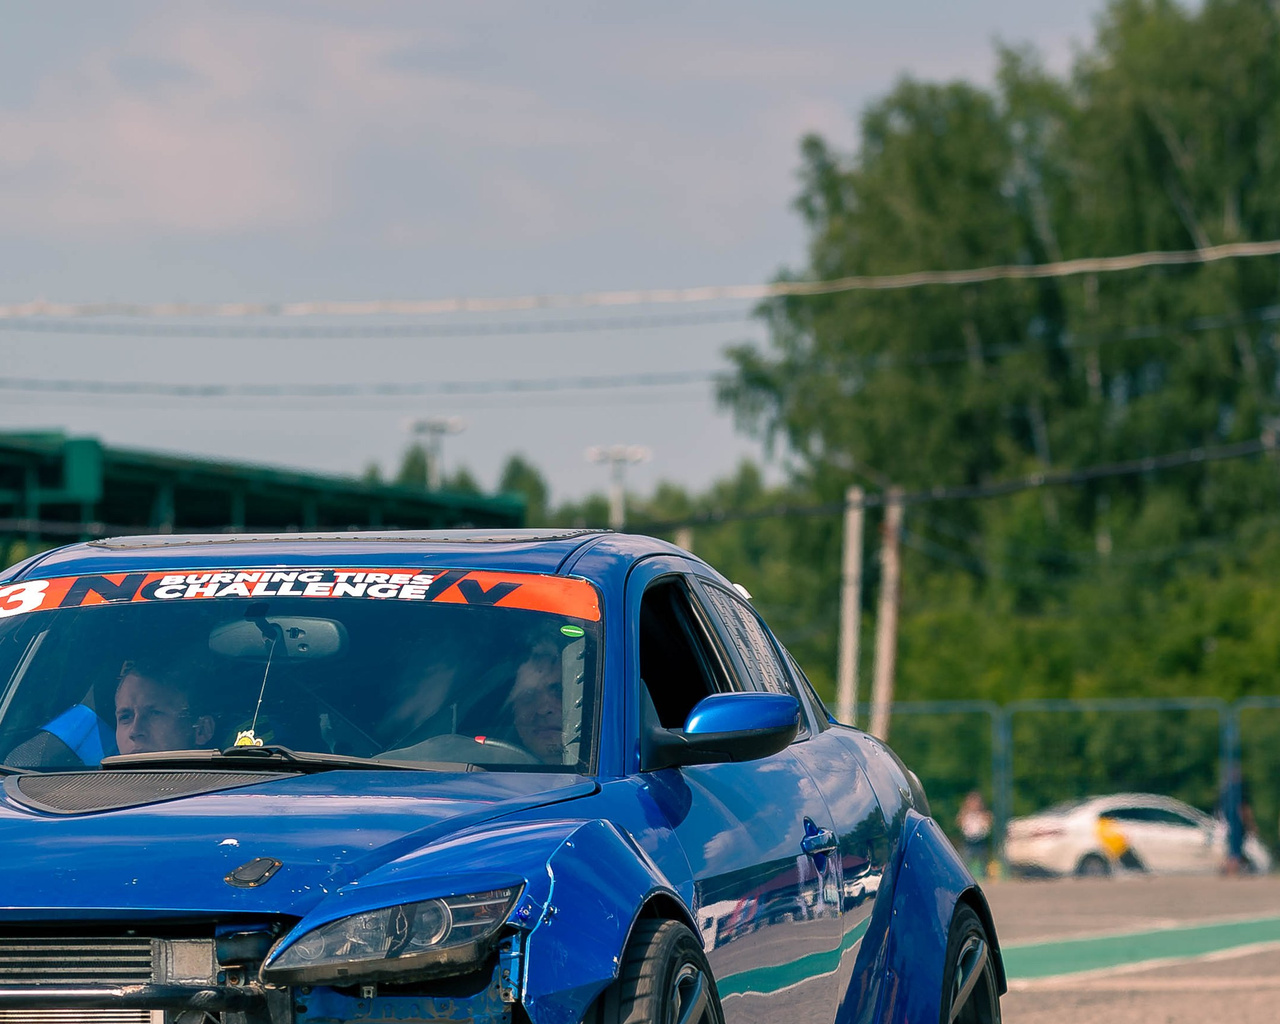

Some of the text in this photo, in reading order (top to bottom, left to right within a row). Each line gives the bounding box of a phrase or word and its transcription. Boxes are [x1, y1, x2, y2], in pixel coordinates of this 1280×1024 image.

[158, 571, 435, 586] BURNING TIRES
[153, 582, 431, 600] CHALLENGE
